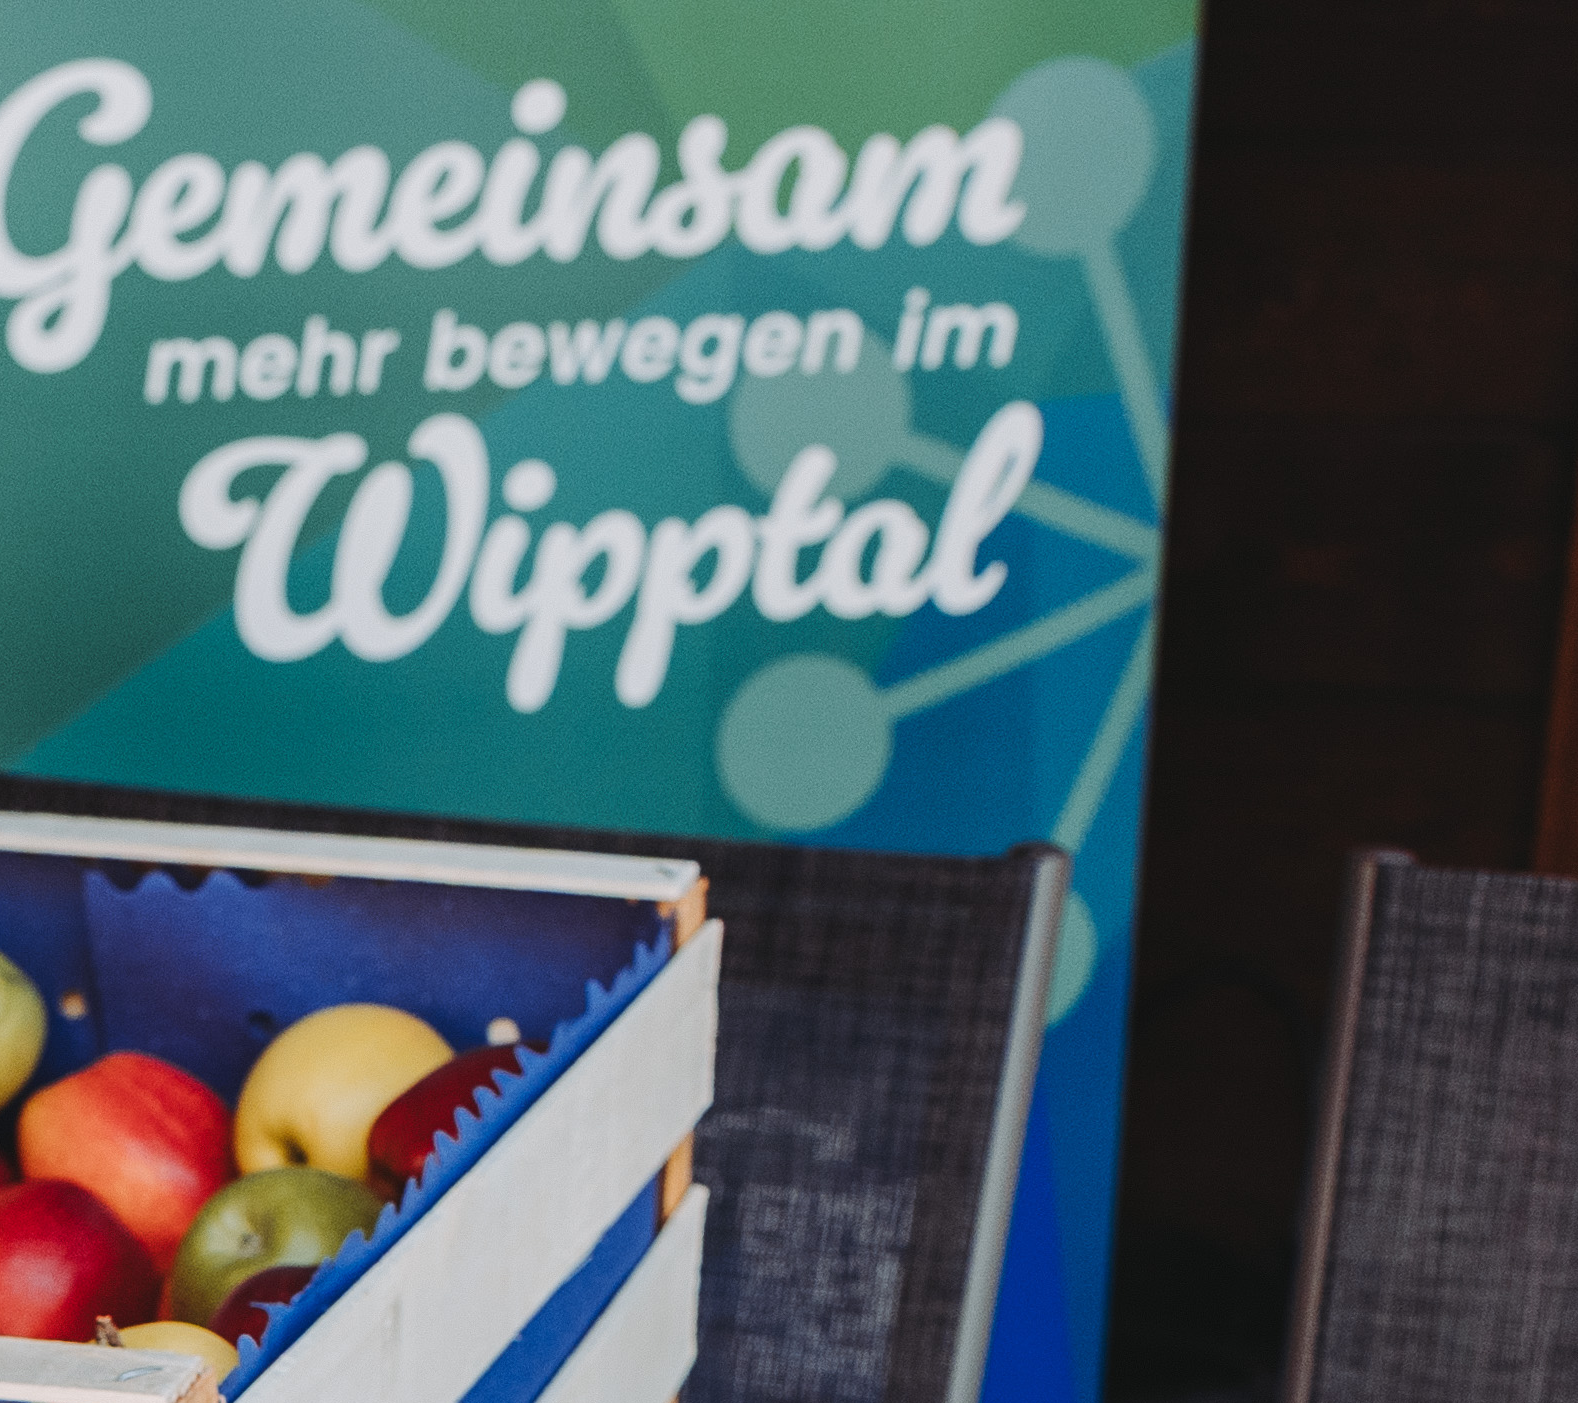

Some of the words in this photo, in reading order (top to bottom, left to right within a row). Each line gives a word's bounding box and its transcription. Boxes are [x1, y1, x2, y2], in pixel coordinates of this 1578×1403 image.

[148, 318, 396, 402] mehr
[426, 308, 862, 403] bewegen
[896, 296, 1016, 368] im
[181, 402, 1041, 710] Wipptal
